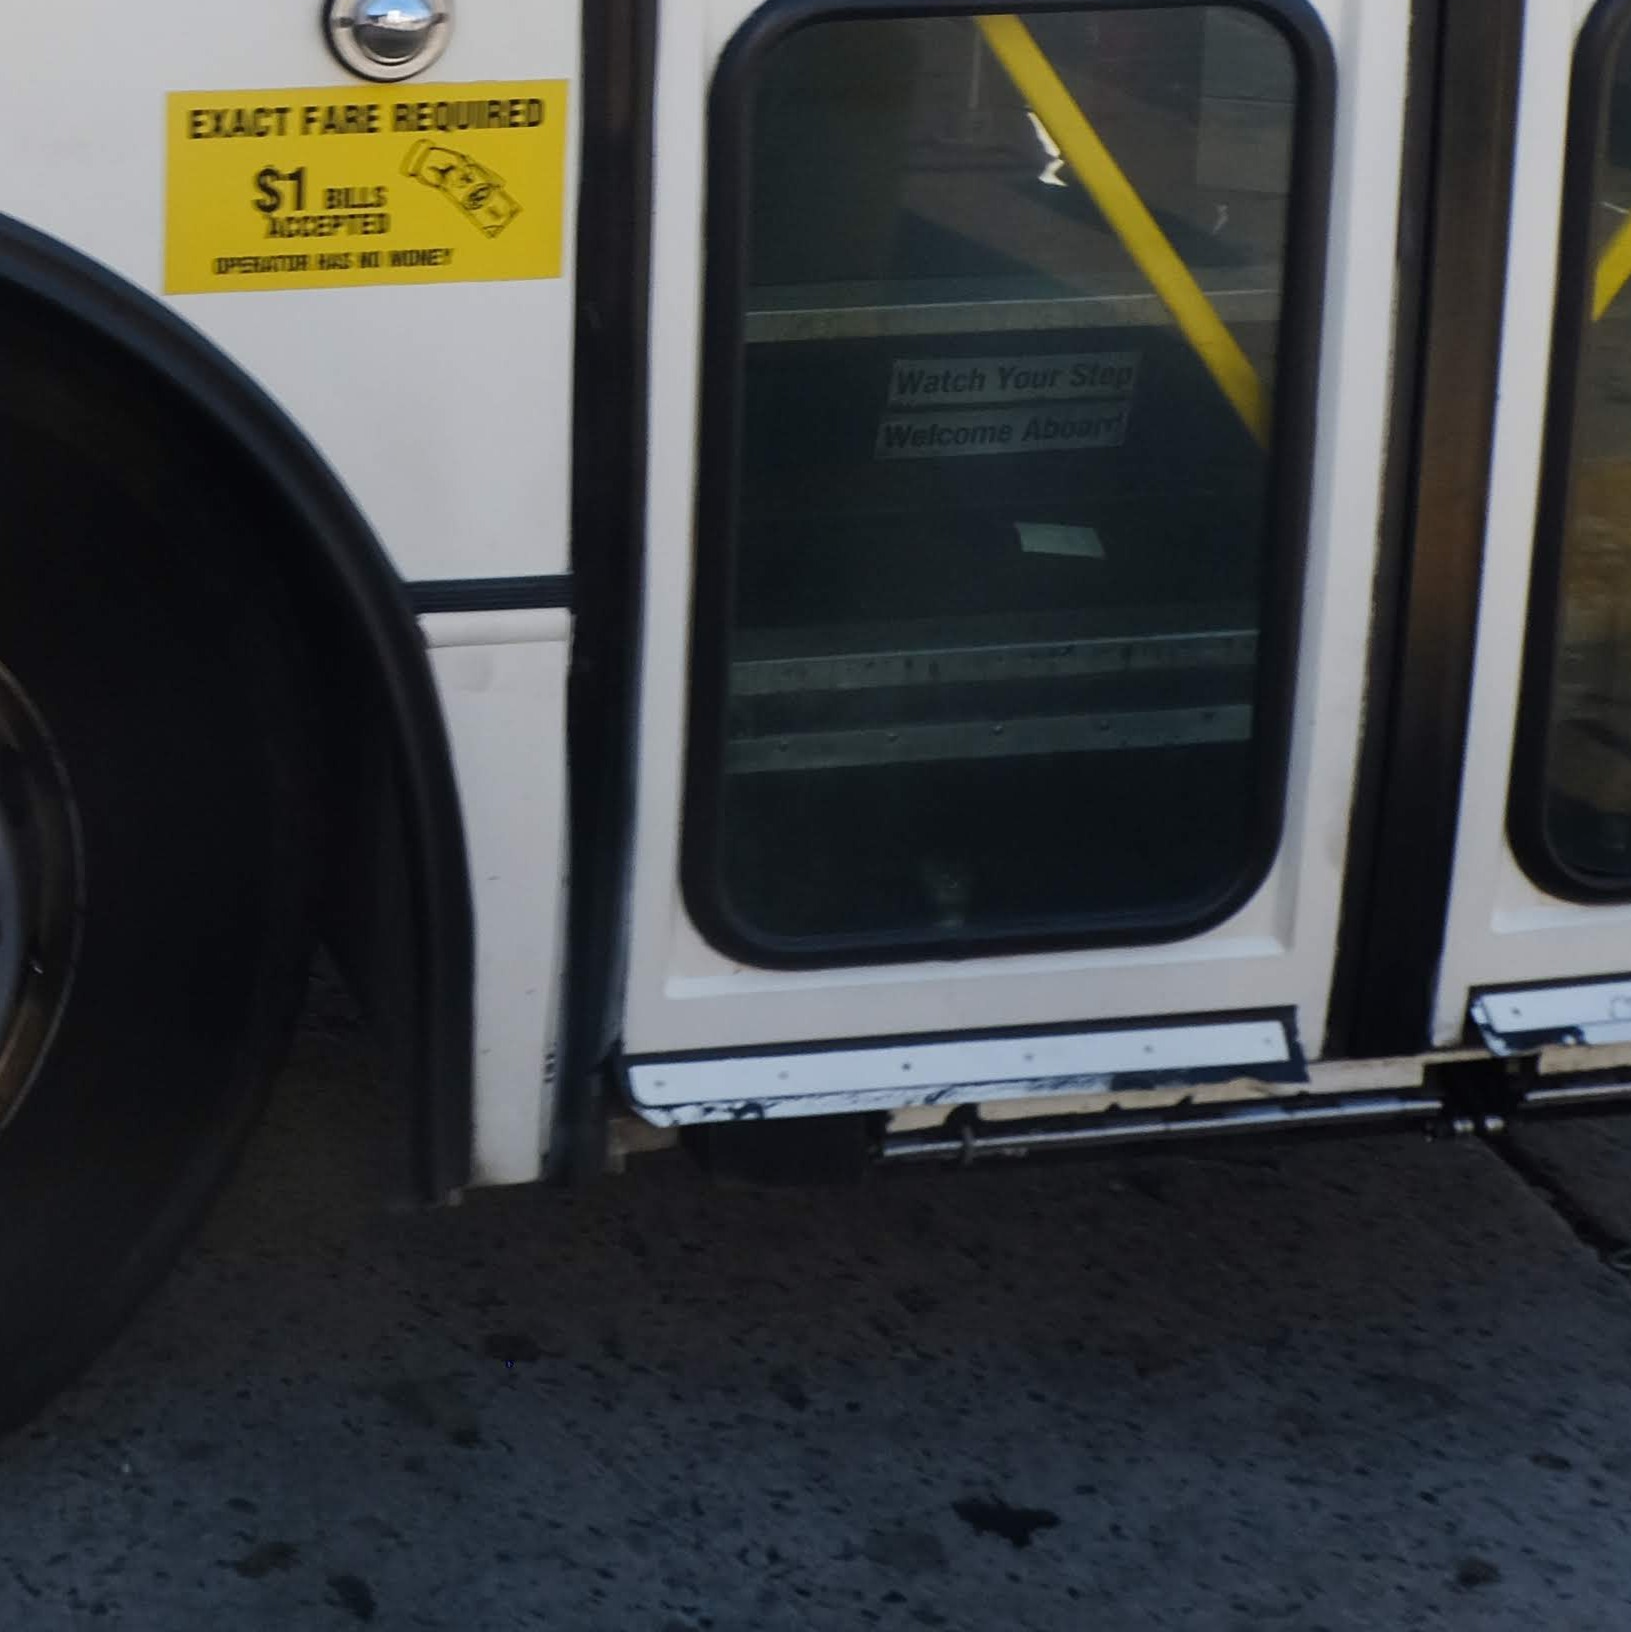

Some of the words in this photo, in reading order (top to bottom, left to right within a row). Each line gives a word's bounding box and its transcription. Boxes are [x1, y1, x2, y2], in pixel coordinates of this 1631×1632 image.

[188, 106, 292, 140] EXACT
[300, 103, 382, 135] FARE
[392, 98, 545, 133] REQUIRED
[253, 163, 308, 215] $1
[322, 186, 388, 211] BILLS
[265, 212, 391, 240] ACCEPTED
[213, 252, 310, 276] OPERATOR
[317, 250, 352, 272] HAS
[356, 250, 385, 270] NO
[389, 247, 455, 269] MONEY
[896, 367, 986, 396] Watch
[998, 365, 1061, 391] Your
[1068, 362, 1135, 391] Step
[883, 421, 1013, 450] Welcome
